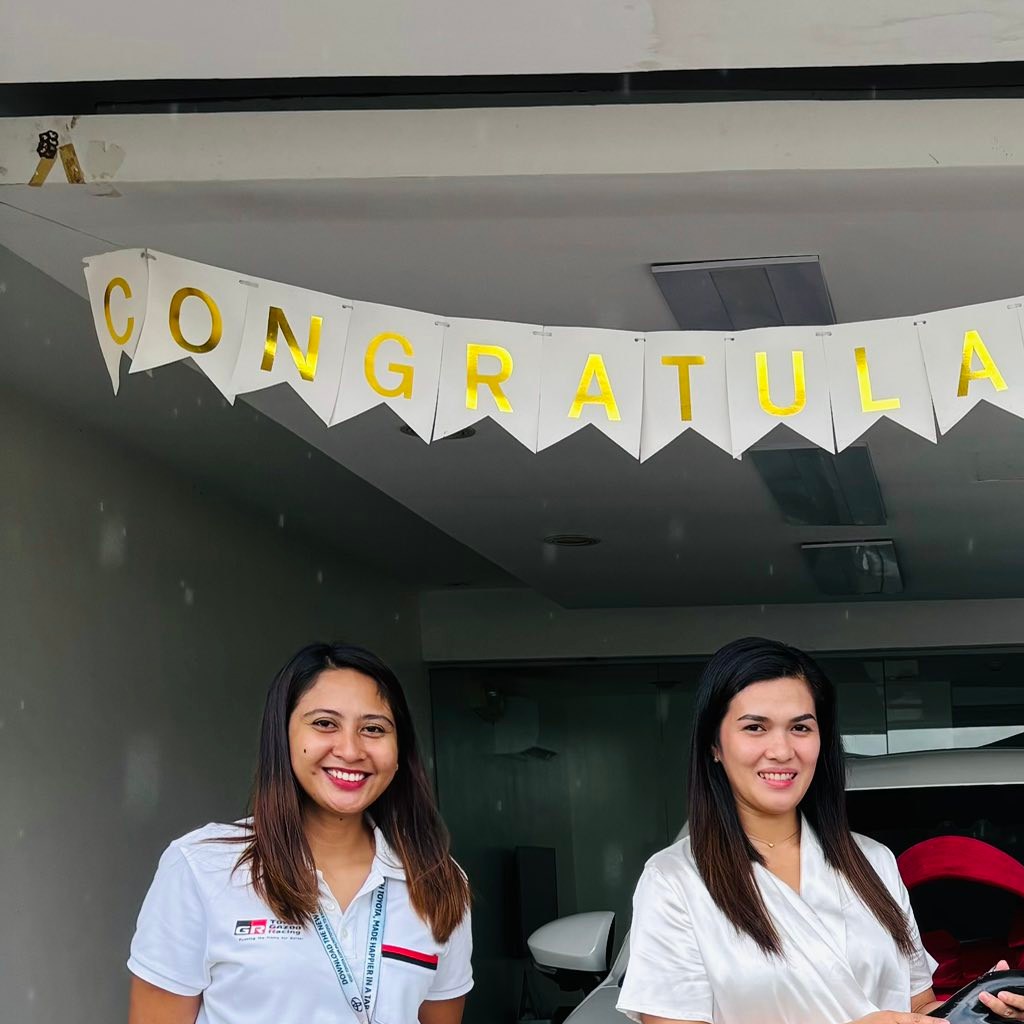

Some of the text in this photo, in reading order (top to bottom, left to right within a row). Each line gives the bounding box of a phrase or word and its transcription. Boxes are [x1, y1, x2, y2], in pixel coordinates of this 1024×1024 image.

[370, 920, 380, 941] MADE
[313, 913, 348, 985] DOWNLOAD THE NEW
[366, 942, 376, 975] HAPPIER
[365, 976, 373, 986] IN
[365, 986, 371, 994] A
